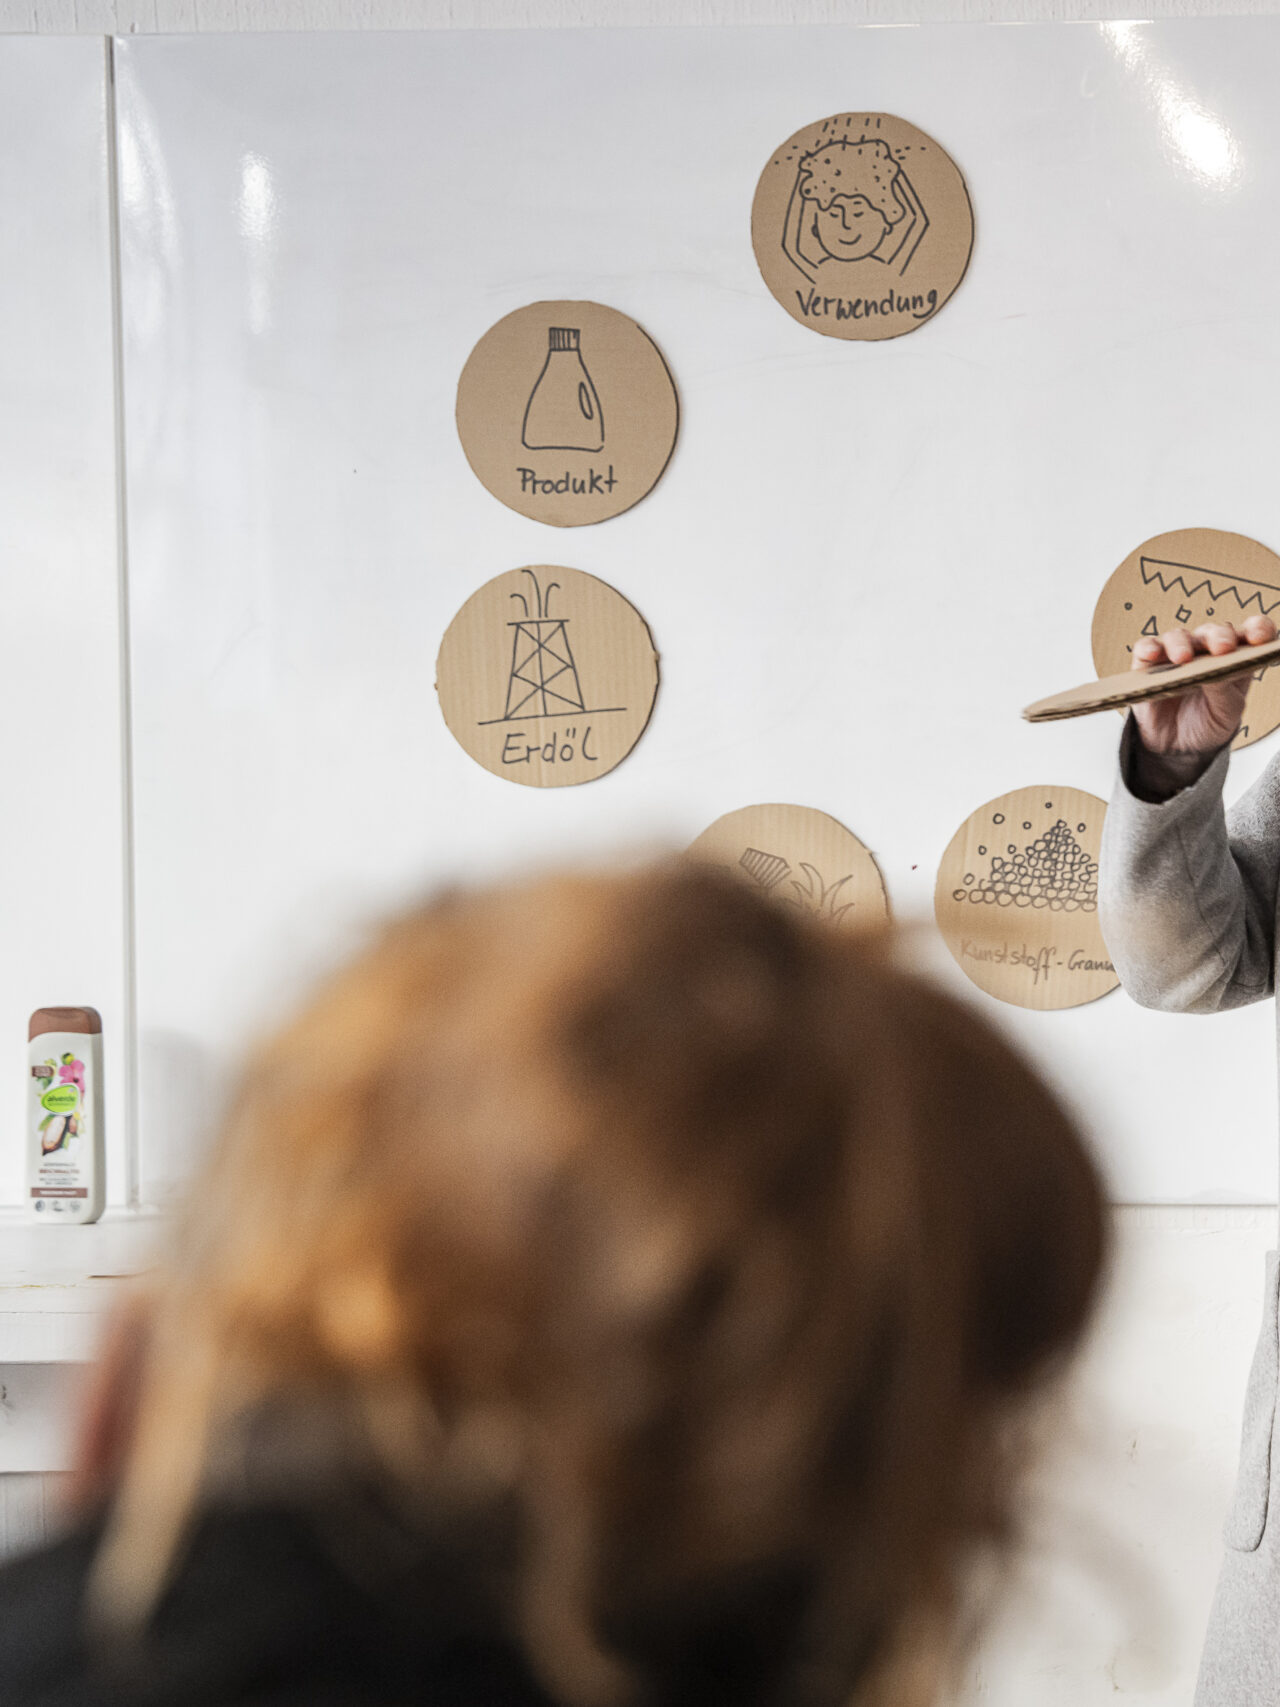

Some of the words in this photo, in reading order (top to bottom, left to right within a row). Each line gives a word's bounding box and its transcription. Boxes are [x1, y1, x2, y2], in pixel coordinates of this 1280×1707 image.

[796, 288, 938, 320] Verwendung
[516, 464, 619, 495] Produkt
[501, 727, 598, 764] Erdöl
